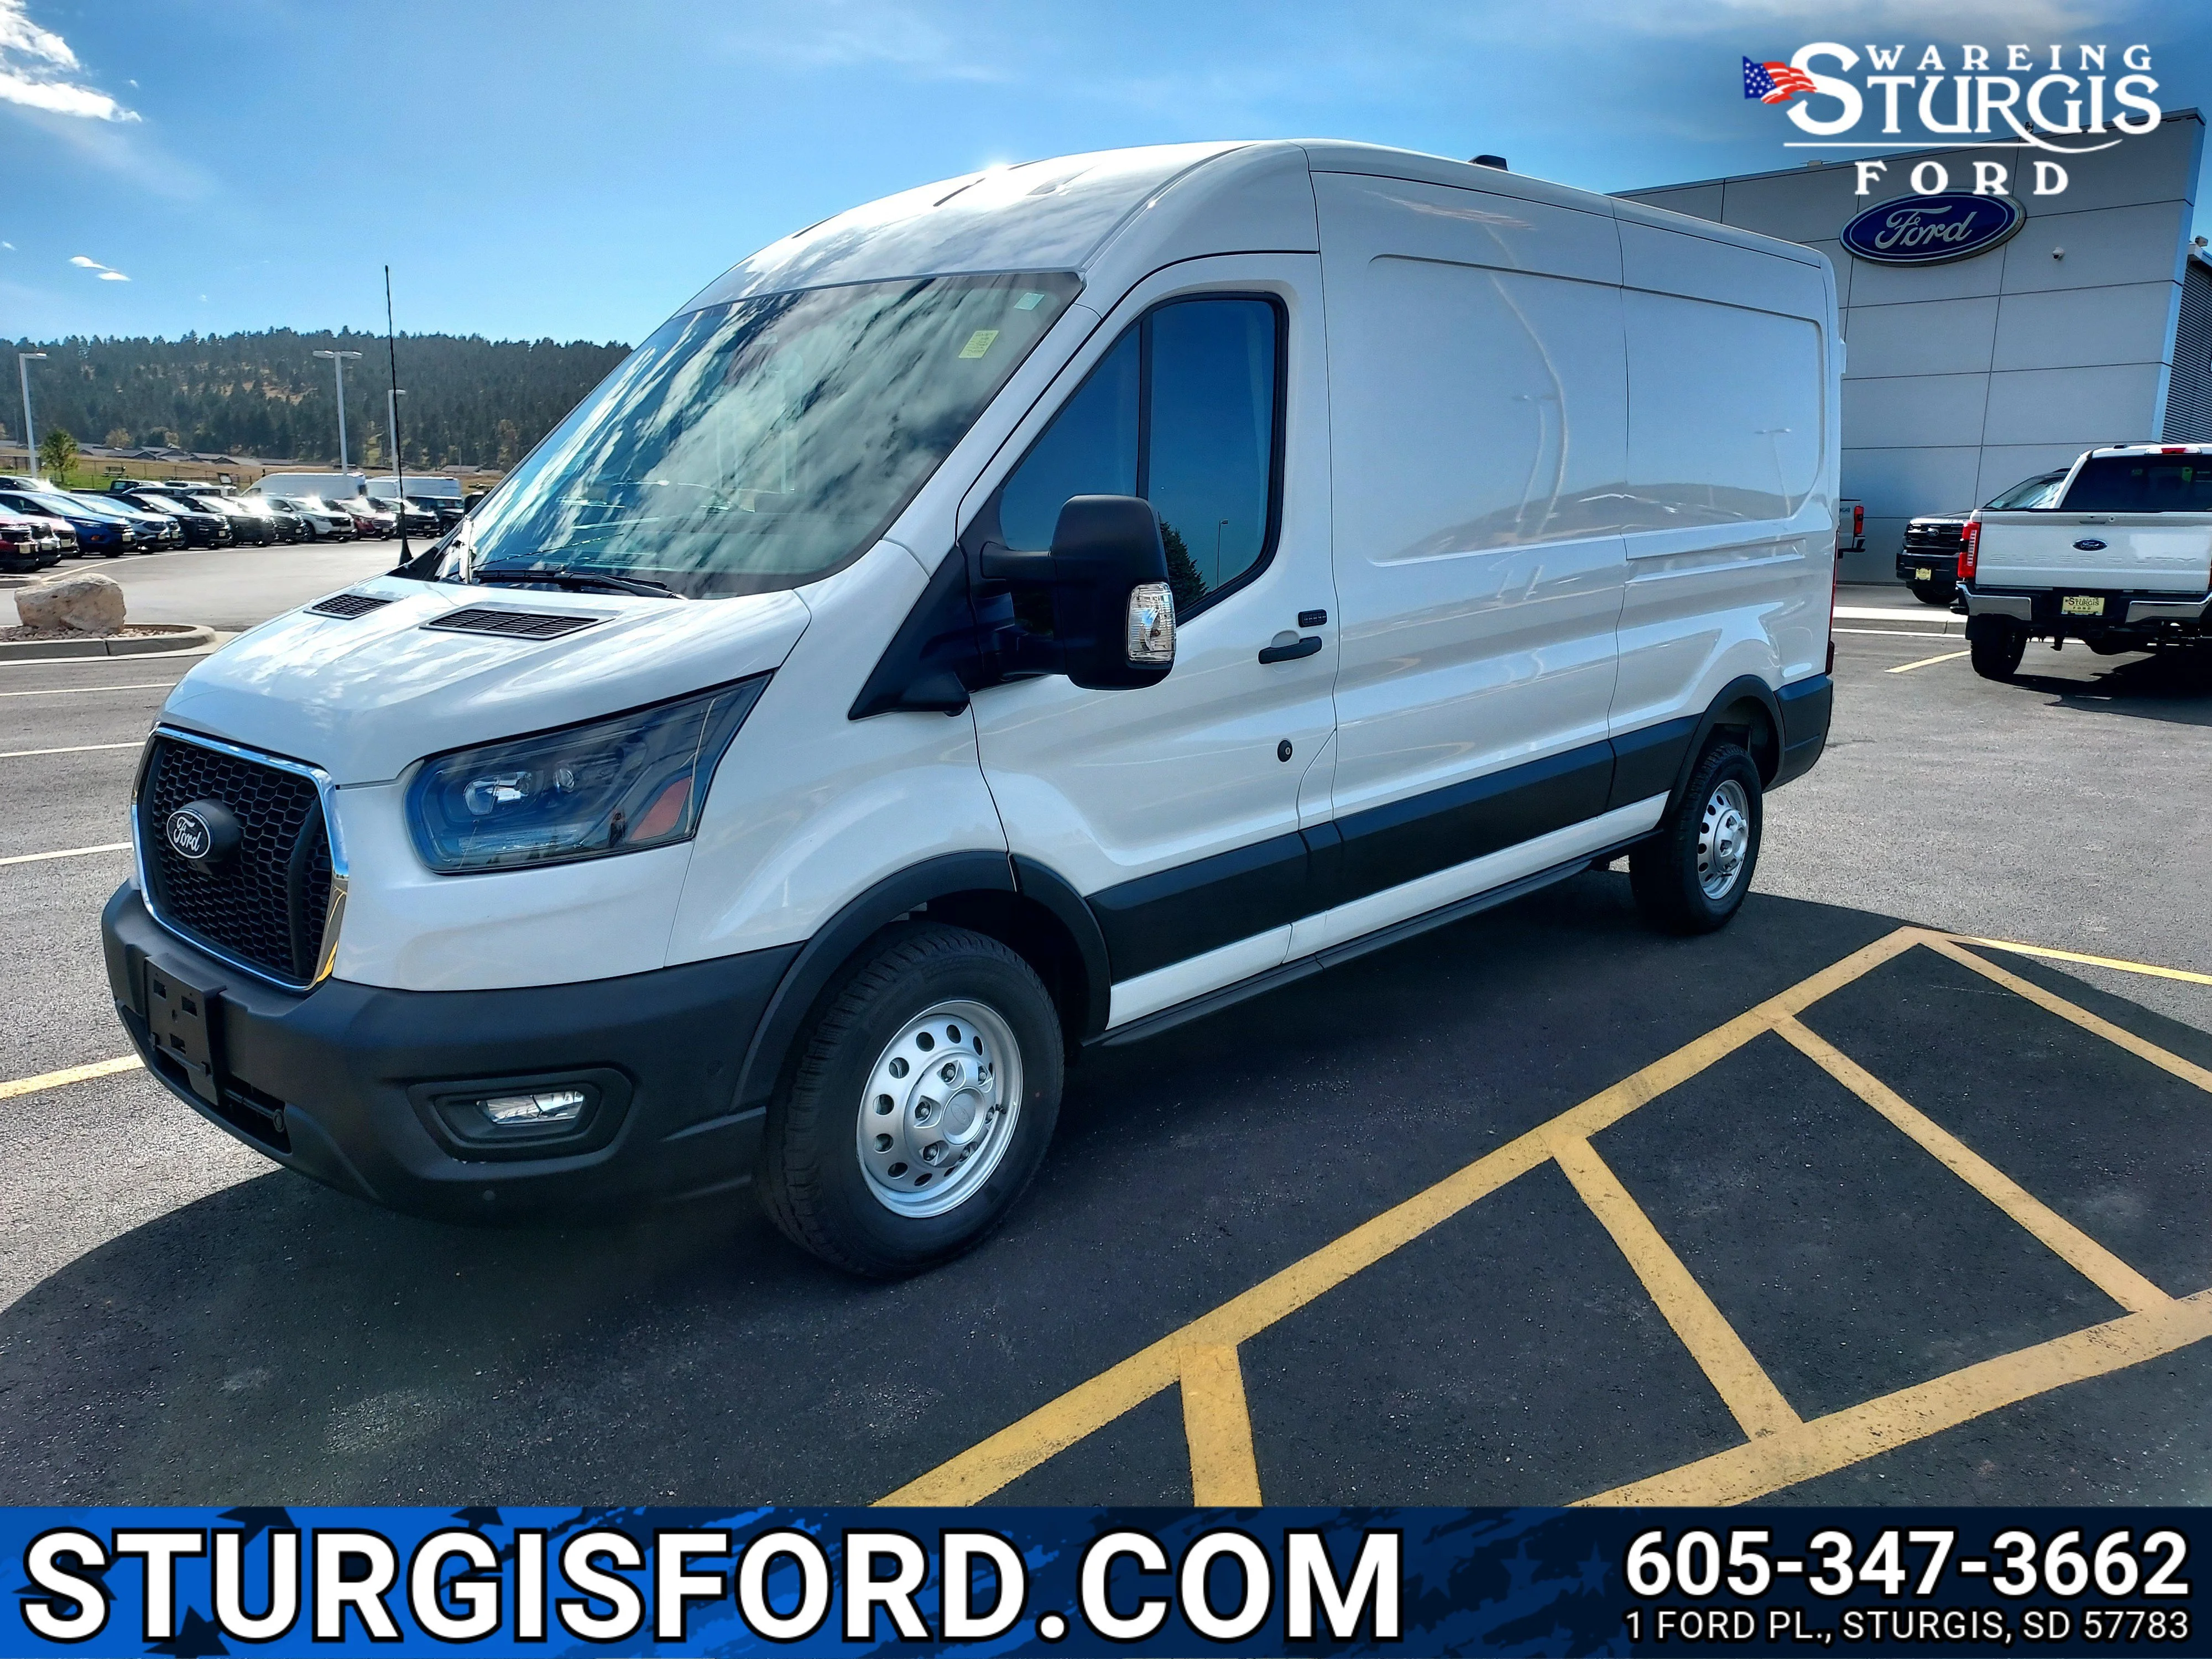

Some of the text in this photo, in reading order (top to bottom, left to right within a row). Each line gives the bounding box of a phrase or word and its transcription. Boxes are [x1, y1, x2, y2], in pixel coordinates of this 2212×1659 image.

[1875, 205, 1978, 249] Ford
[2068, 597, 2099, 606] STURGIS
[173, 816, 202, 852] Ford
